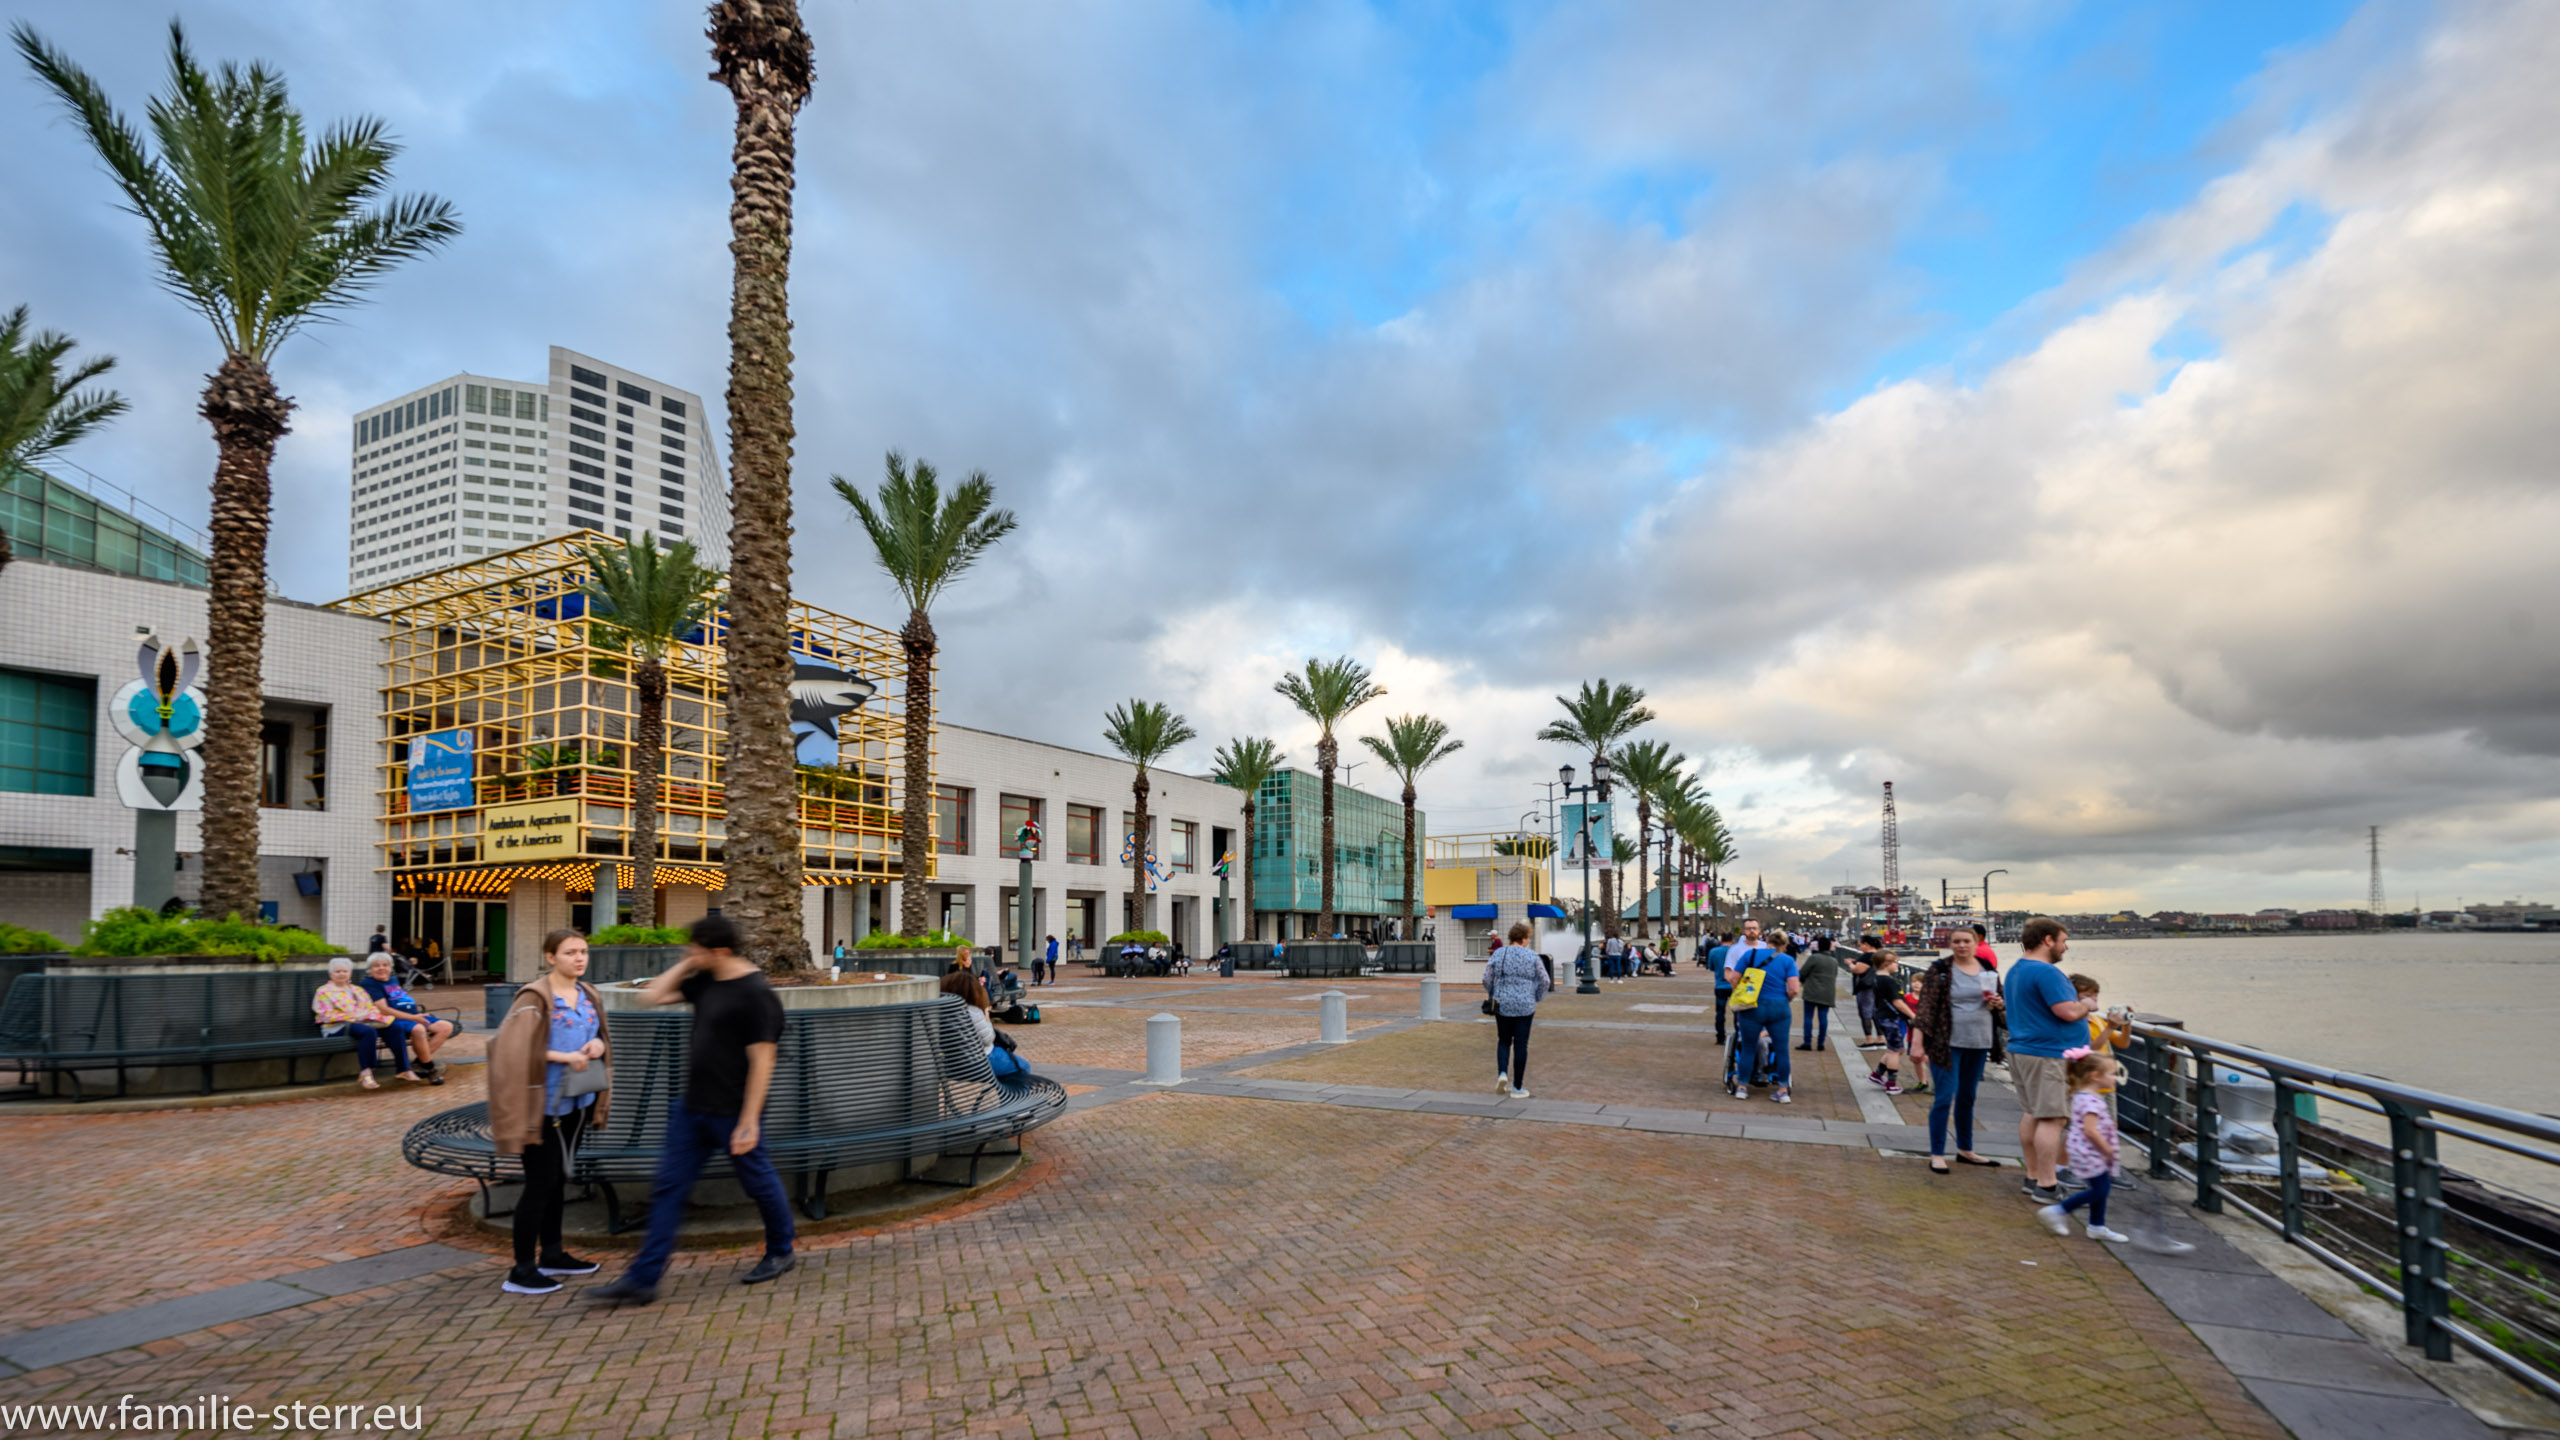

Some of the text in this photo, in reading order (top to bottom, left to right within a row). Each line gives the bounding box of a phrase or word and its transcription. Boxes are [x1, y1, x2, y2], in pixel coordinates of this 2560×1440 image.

[489, 813, 571, 831] Audubon Aquarium
[495, 833, 562, 848] of the Americas
